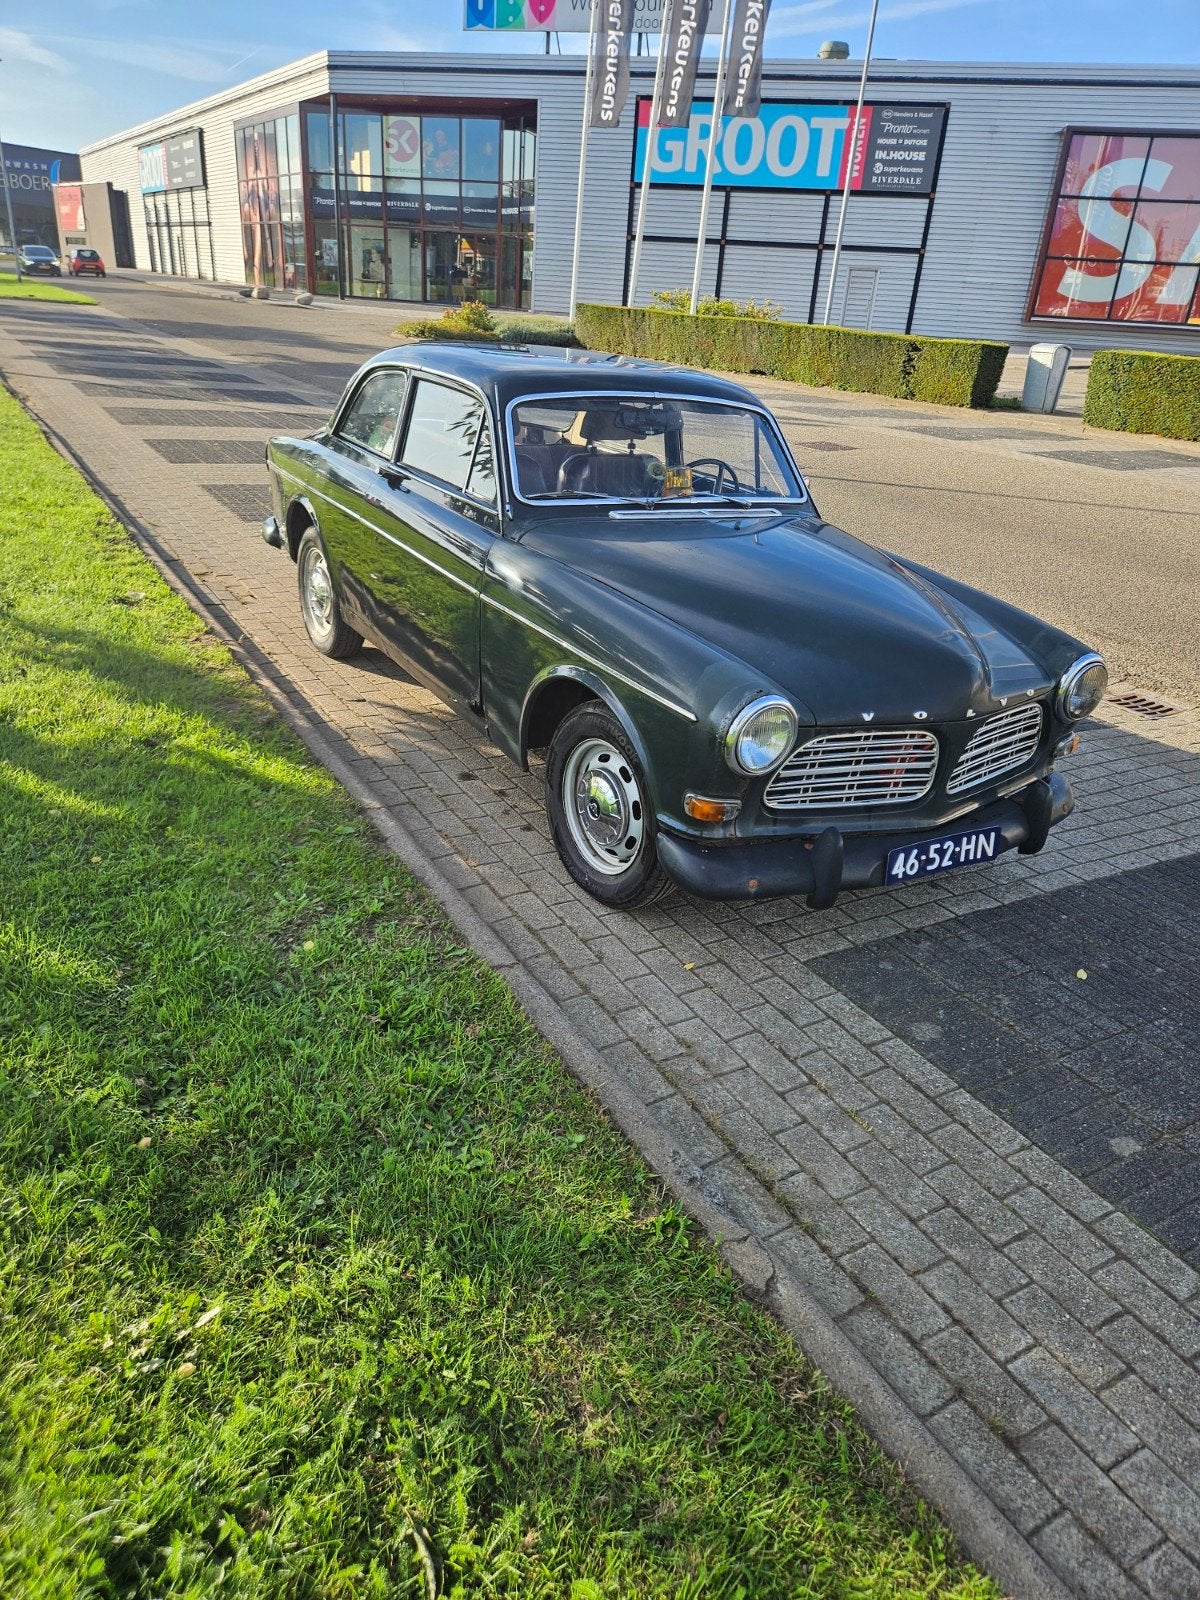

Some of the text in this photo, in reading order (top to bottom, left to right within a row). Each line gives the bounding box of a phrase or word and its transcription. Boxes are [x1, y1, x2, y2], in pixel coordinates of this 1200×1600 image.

[880, 122, 917, 134] Pronto
[388, 128, 414, 154] SK
[651, 115, 851, 177] GROOT
[875, 150, 926, 161] IN.HOUSE
[1, 160, 48, 170] RWASH
[872, 176, 922, 184] RIVERDALE
[386, 200, 419, 208] RIVERDALE
[861, 688, 1035, 721] VOLVO
